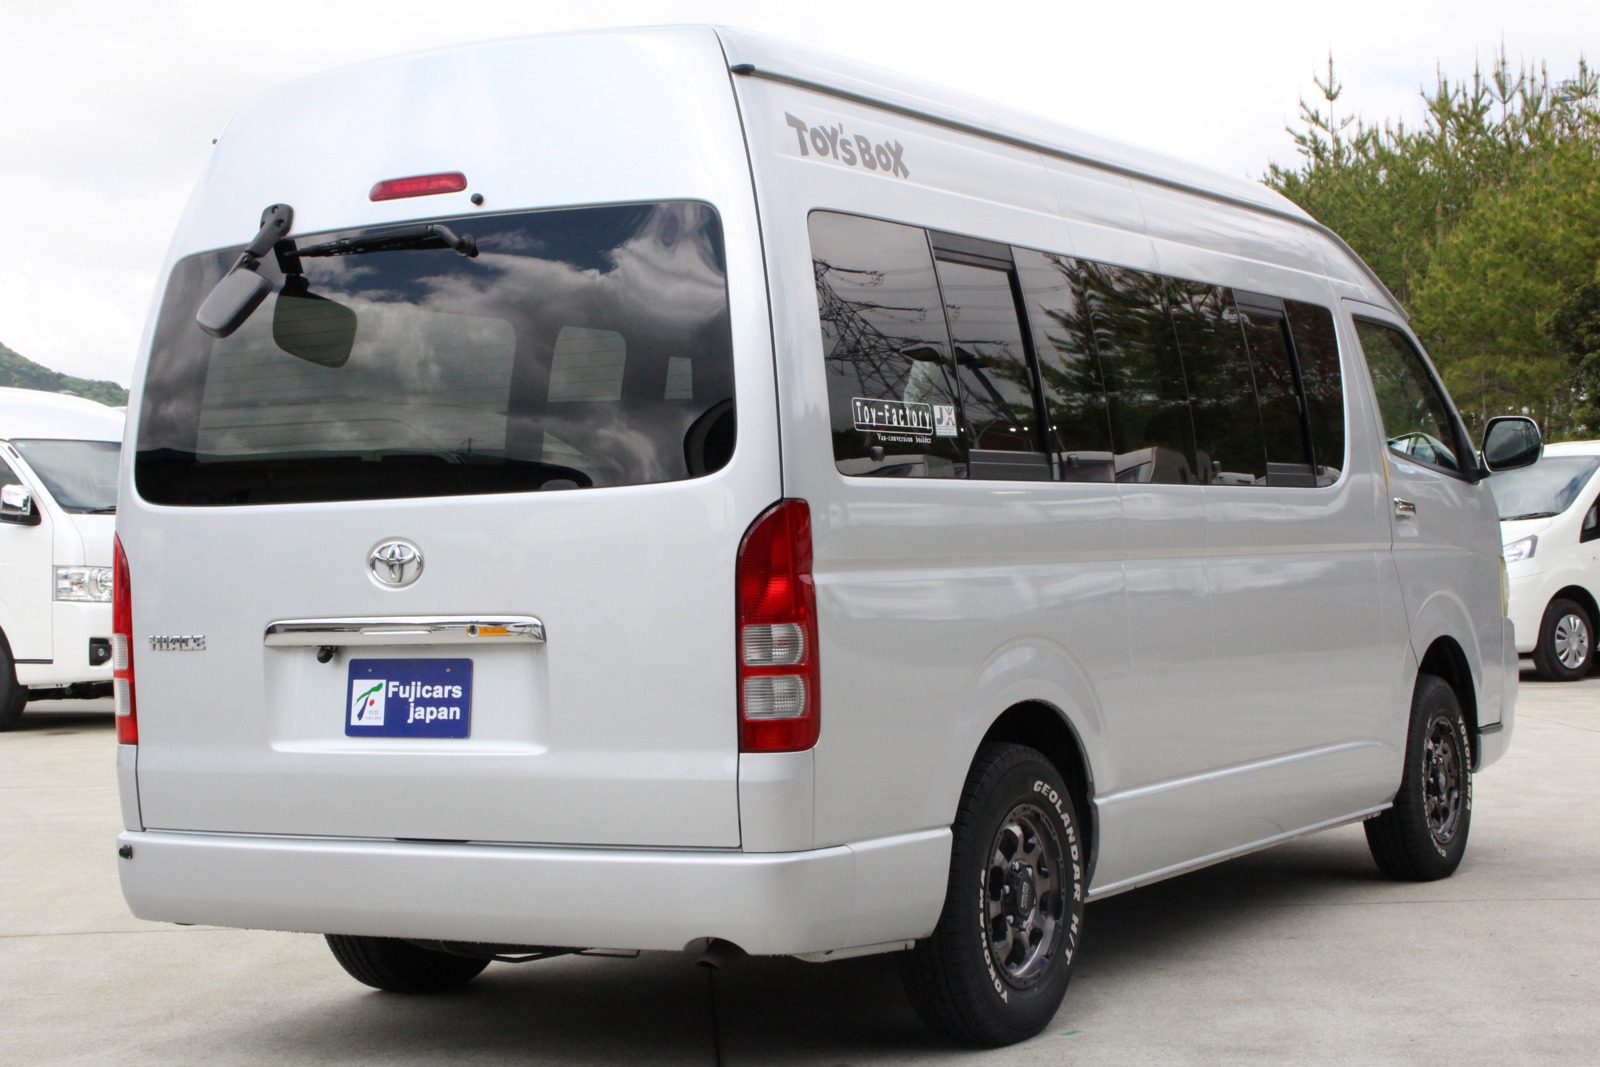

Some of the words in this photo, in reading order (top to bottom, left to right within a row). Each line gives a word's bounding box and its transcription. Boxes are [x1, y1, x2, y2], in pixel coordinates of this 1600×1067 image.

[149, 635, 206, 651] HIACE
[388, 681, 463, 702] Fujicars
[407, 703, 461, 723] japan
[1033, 780, 1081, 902] GEOLANDAR
